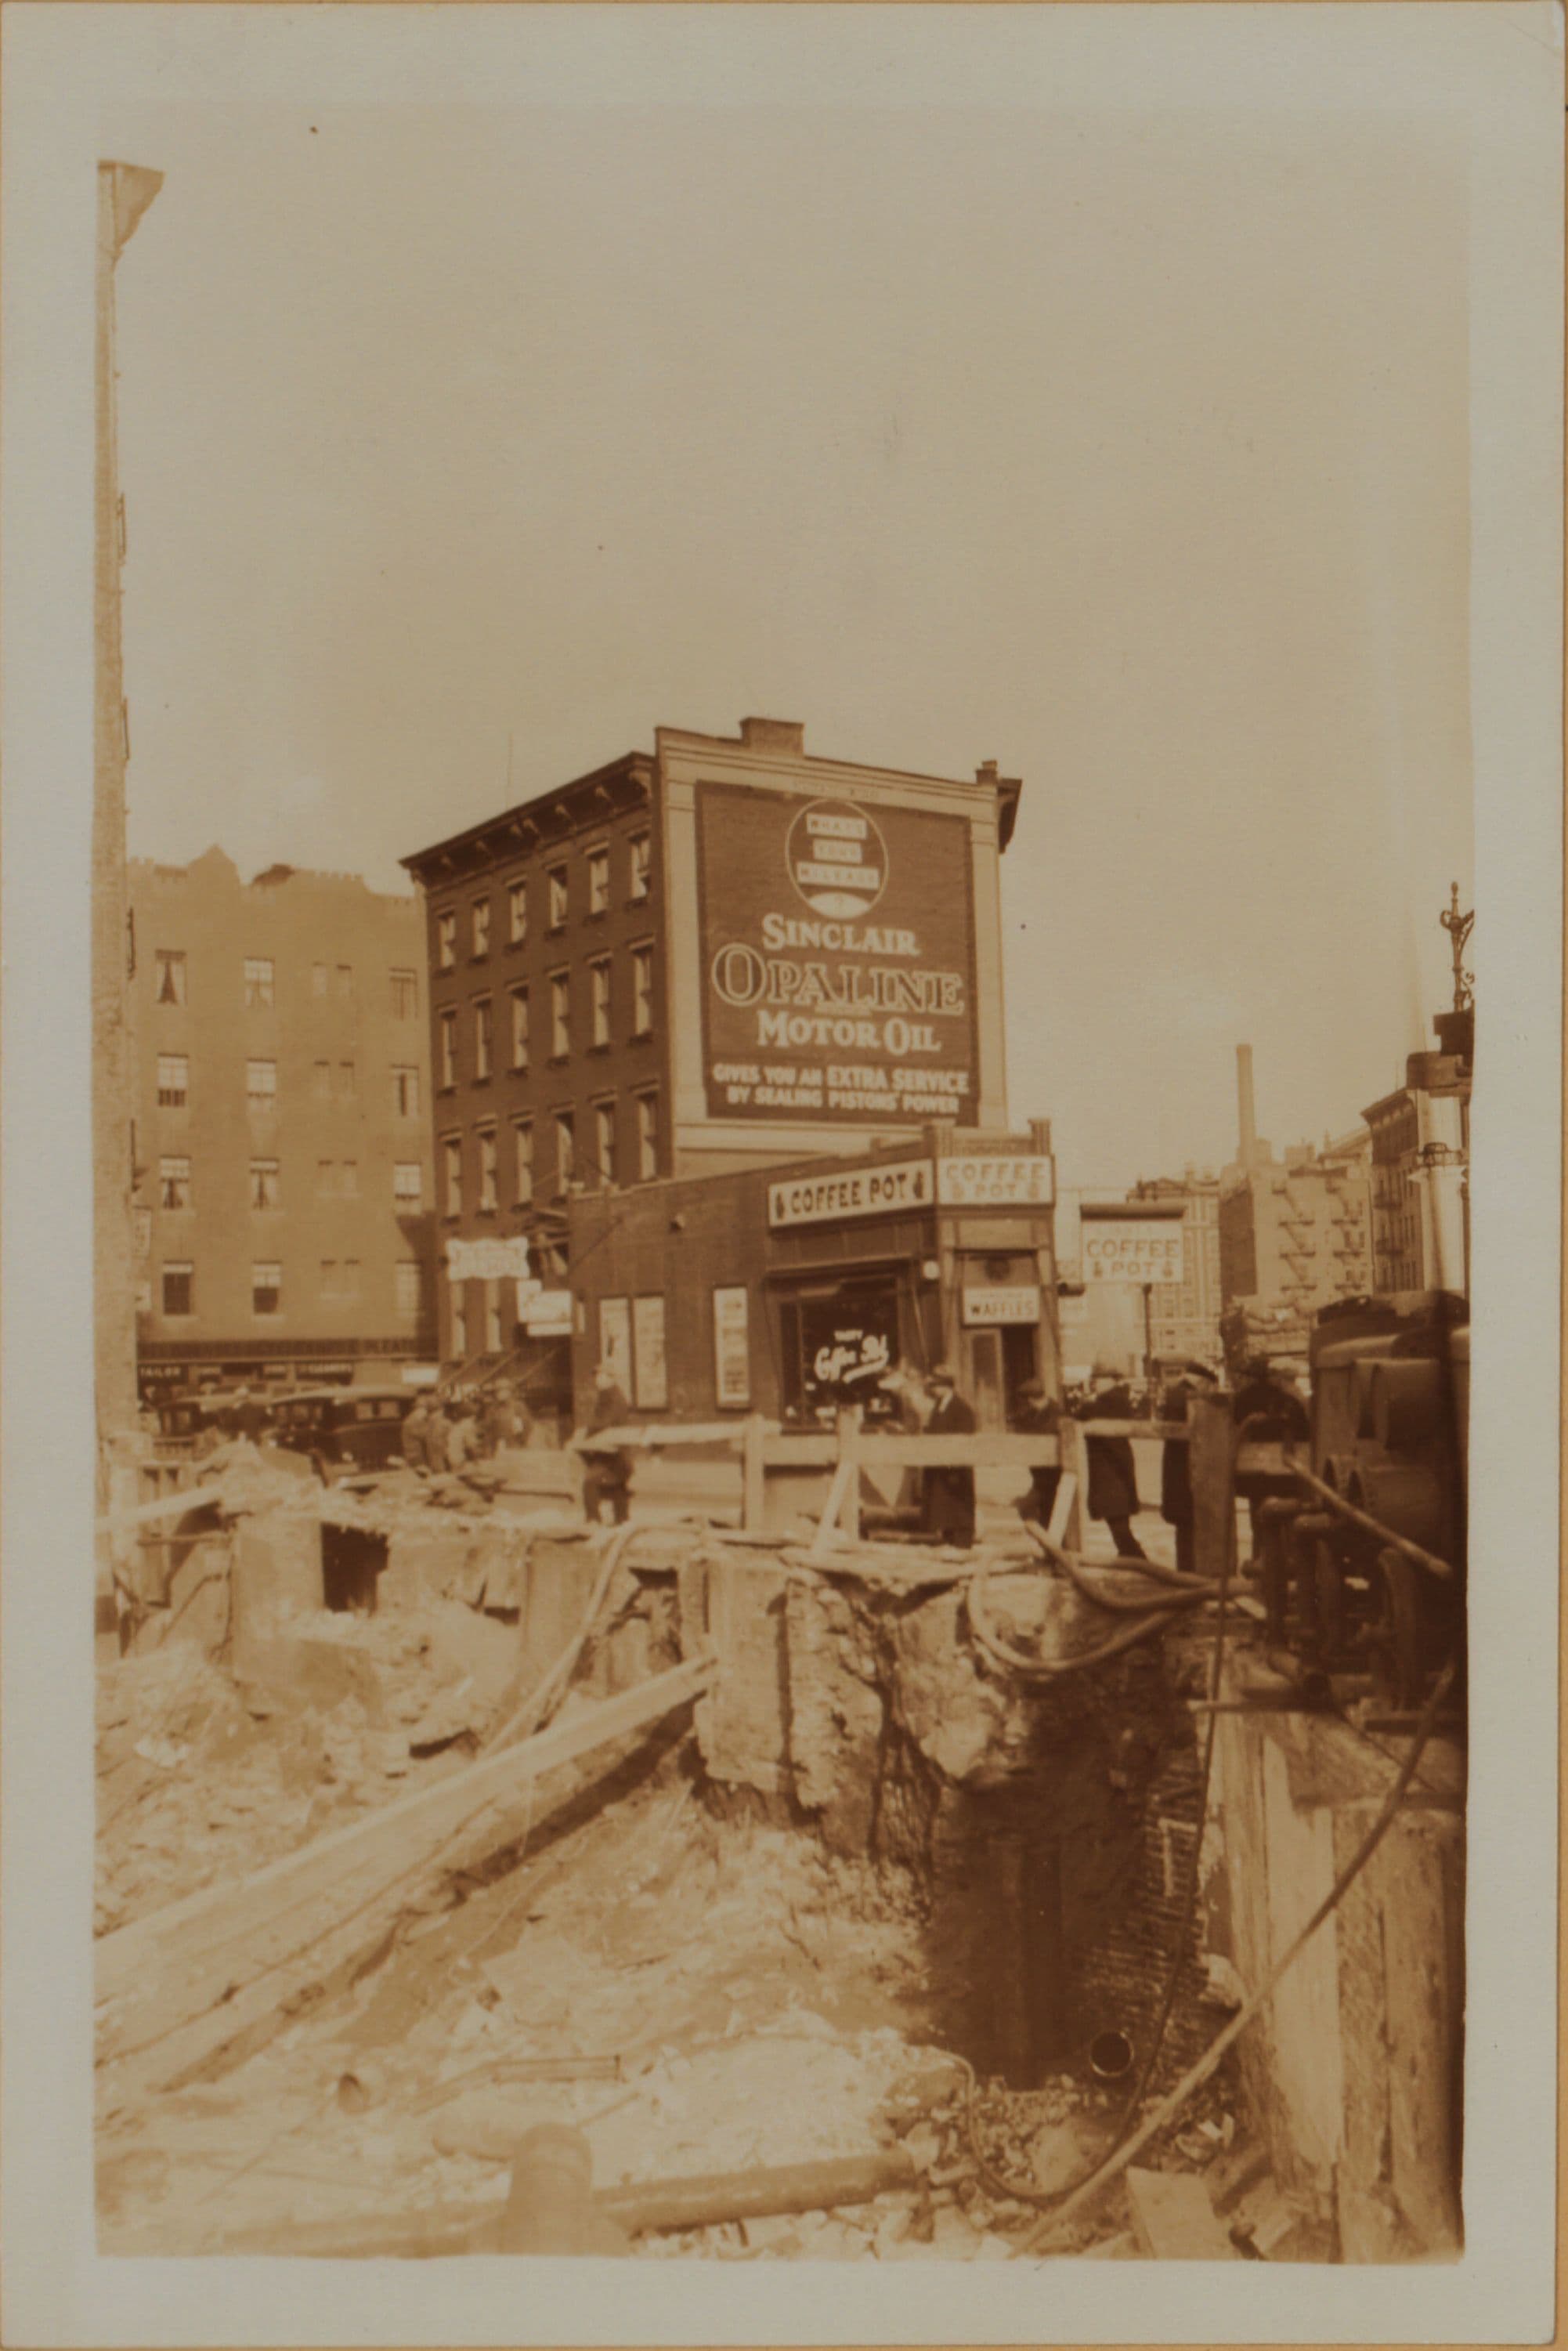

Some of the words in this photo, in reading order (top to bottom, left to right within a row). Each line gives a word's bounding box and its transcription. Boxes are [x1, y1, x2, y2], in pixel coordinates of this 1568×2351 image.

[762, 913, 921, 957] SINCLAIR
[711, 942, 965, 1016] OPALINE
[757, 1010, 880, 1049] MOTOR
[883, 1018, 941, 1056] OIL
[713, 1063, 761, 1084] GIVES
[764, 1065, 796, 1085] YOU
[799, 1068, 822, 1087] AN
[826, 1065, 888, 1091] EXTRA
[892, 1068, 970, 1094] SERVICE
[727, 1085, 750, 1104] BY
[754, 1087, 822, 1108] SEALING
[902, 1094, 959, 1114] POWER
[946, 1163, 1045, 1181] COFFEE
[791, 1178, 861, 1214] COFFEE
[869, 1173, 907, 1202] POT
[975, 1183, 1017, 1198] POT
[1086, 1238, 1179, 1258] COFFEE
[1111, 1260, 1154, 1276] POT
[970, 1300, 1035, 1317] WAFFLES
